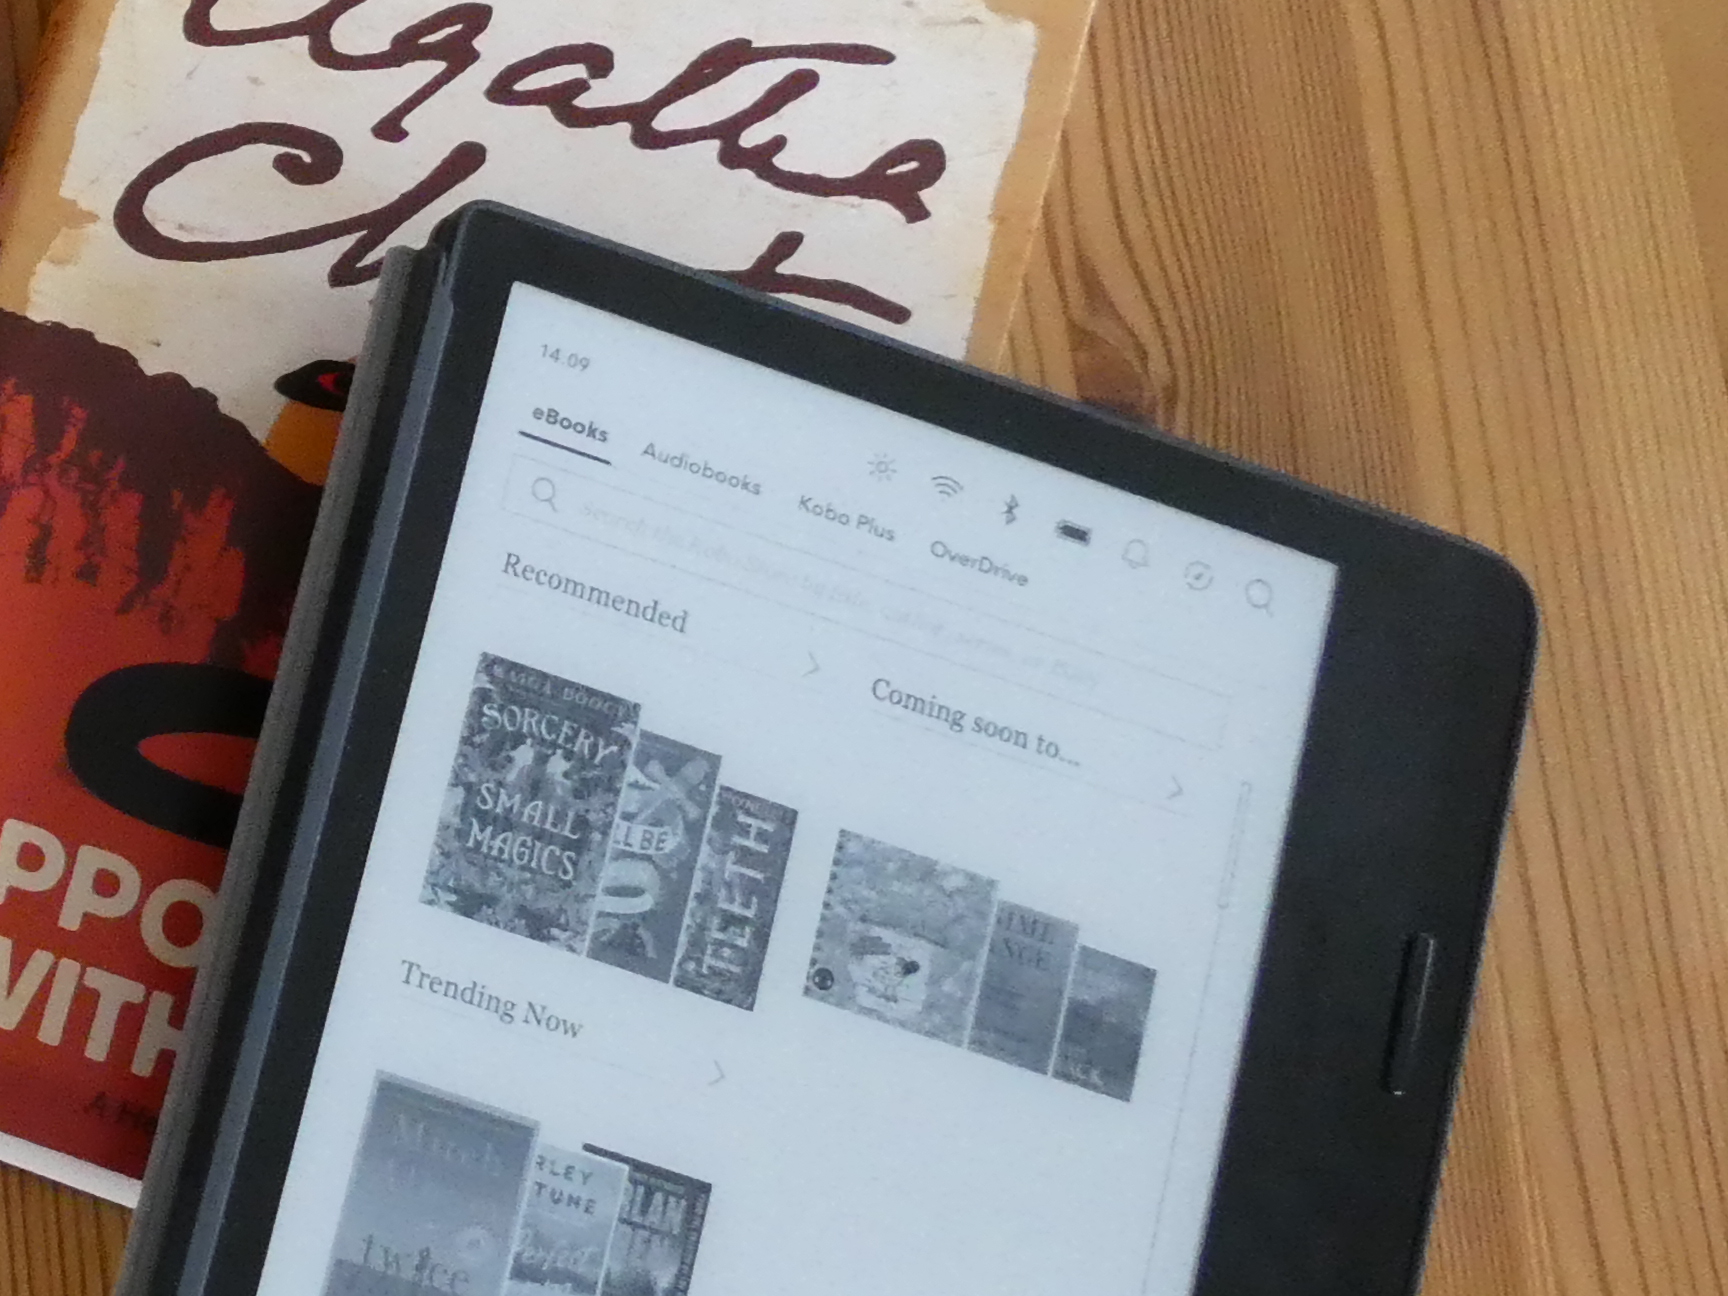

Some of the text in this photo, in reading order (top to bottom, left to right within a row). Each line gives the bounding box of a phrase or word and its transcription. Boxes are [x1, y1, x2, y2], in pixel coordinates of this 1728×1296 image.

[532, 407, 1029, 587] eBooks Audiobooks Kobo Plus OverDrive
[502, 551, 690, 634] Recommended
[483, 703, 620, 764] SORCERY
[871, 677, 967, 734] Coming
[971, 713, 1031, 754] soon
[476, 782, 581, 839] SMALL
[467, 818, 577, 881] MAGICS
[400, 959, 584, 1040] Trending Now
